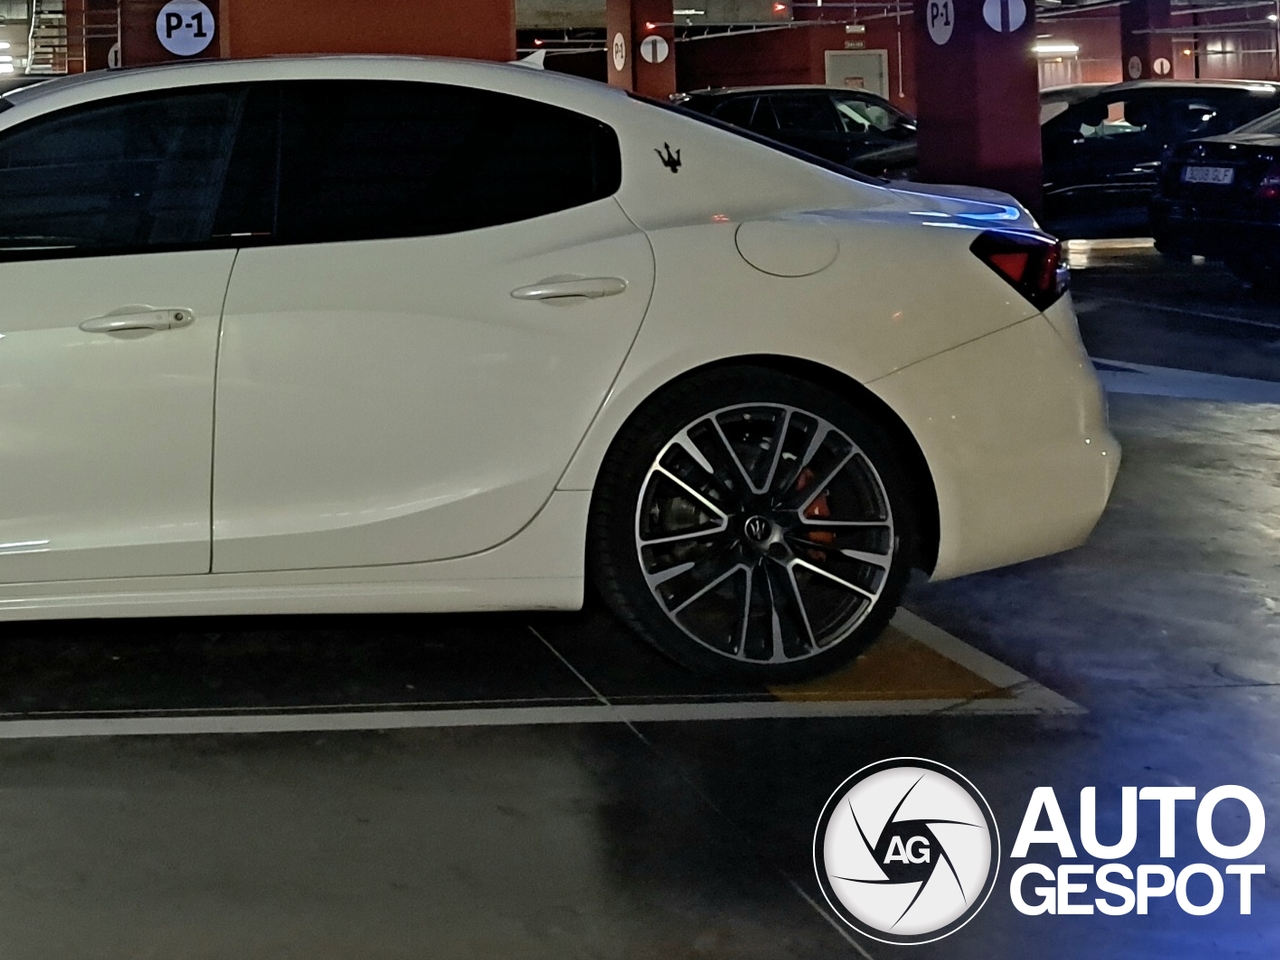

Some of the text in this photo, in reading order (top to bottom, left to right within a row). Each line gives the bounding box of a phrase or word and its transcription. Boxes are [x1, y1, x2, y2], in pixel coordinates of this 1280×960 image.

[165, 11, 207, 39] P-1
[930, 1, 951, 28] P-1
[614, 42, 624, 60] P-1
